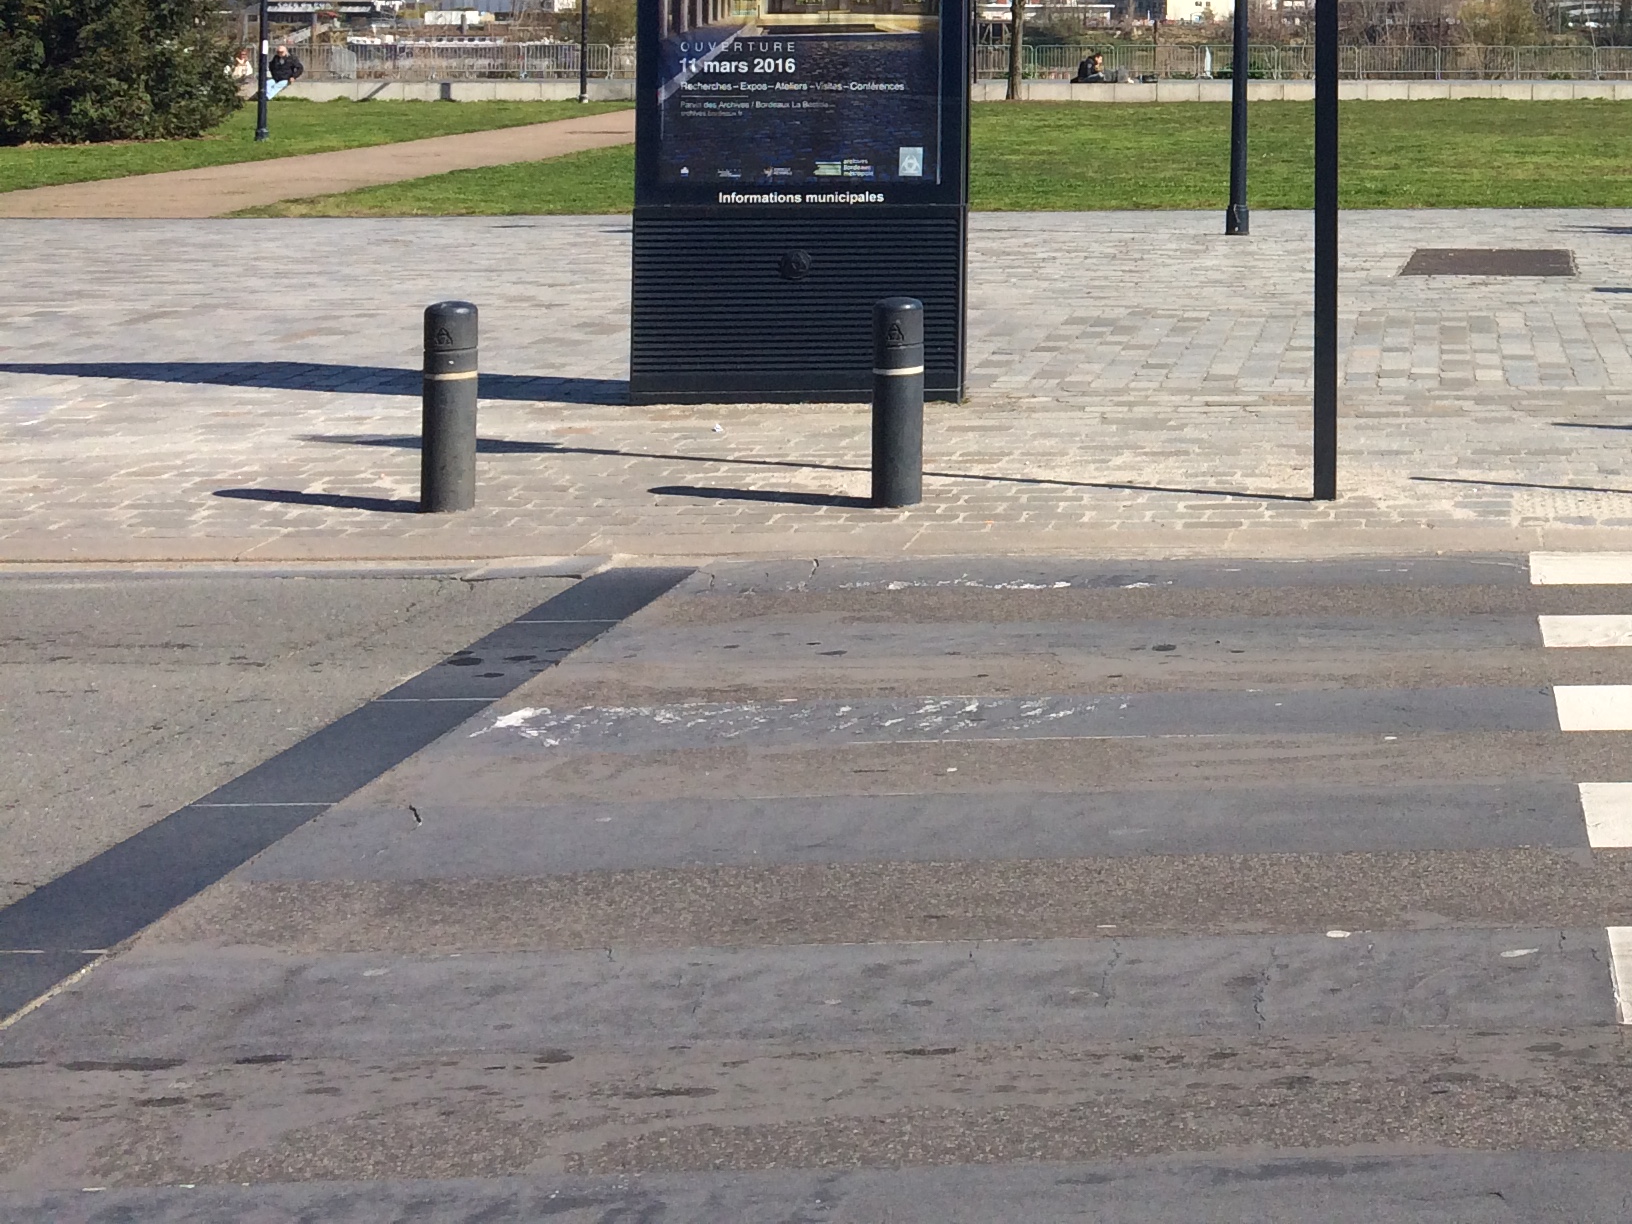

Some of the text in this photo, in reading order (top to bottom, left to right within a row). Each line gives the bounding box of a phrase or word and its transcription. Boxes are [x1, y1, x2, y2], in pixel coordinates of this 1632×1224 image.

[680, 41, 796, 52] OUVERTURE
[679, 57, 797, 73] 11 mars 2016
[718, 191, 885, 205] Informations municipales
